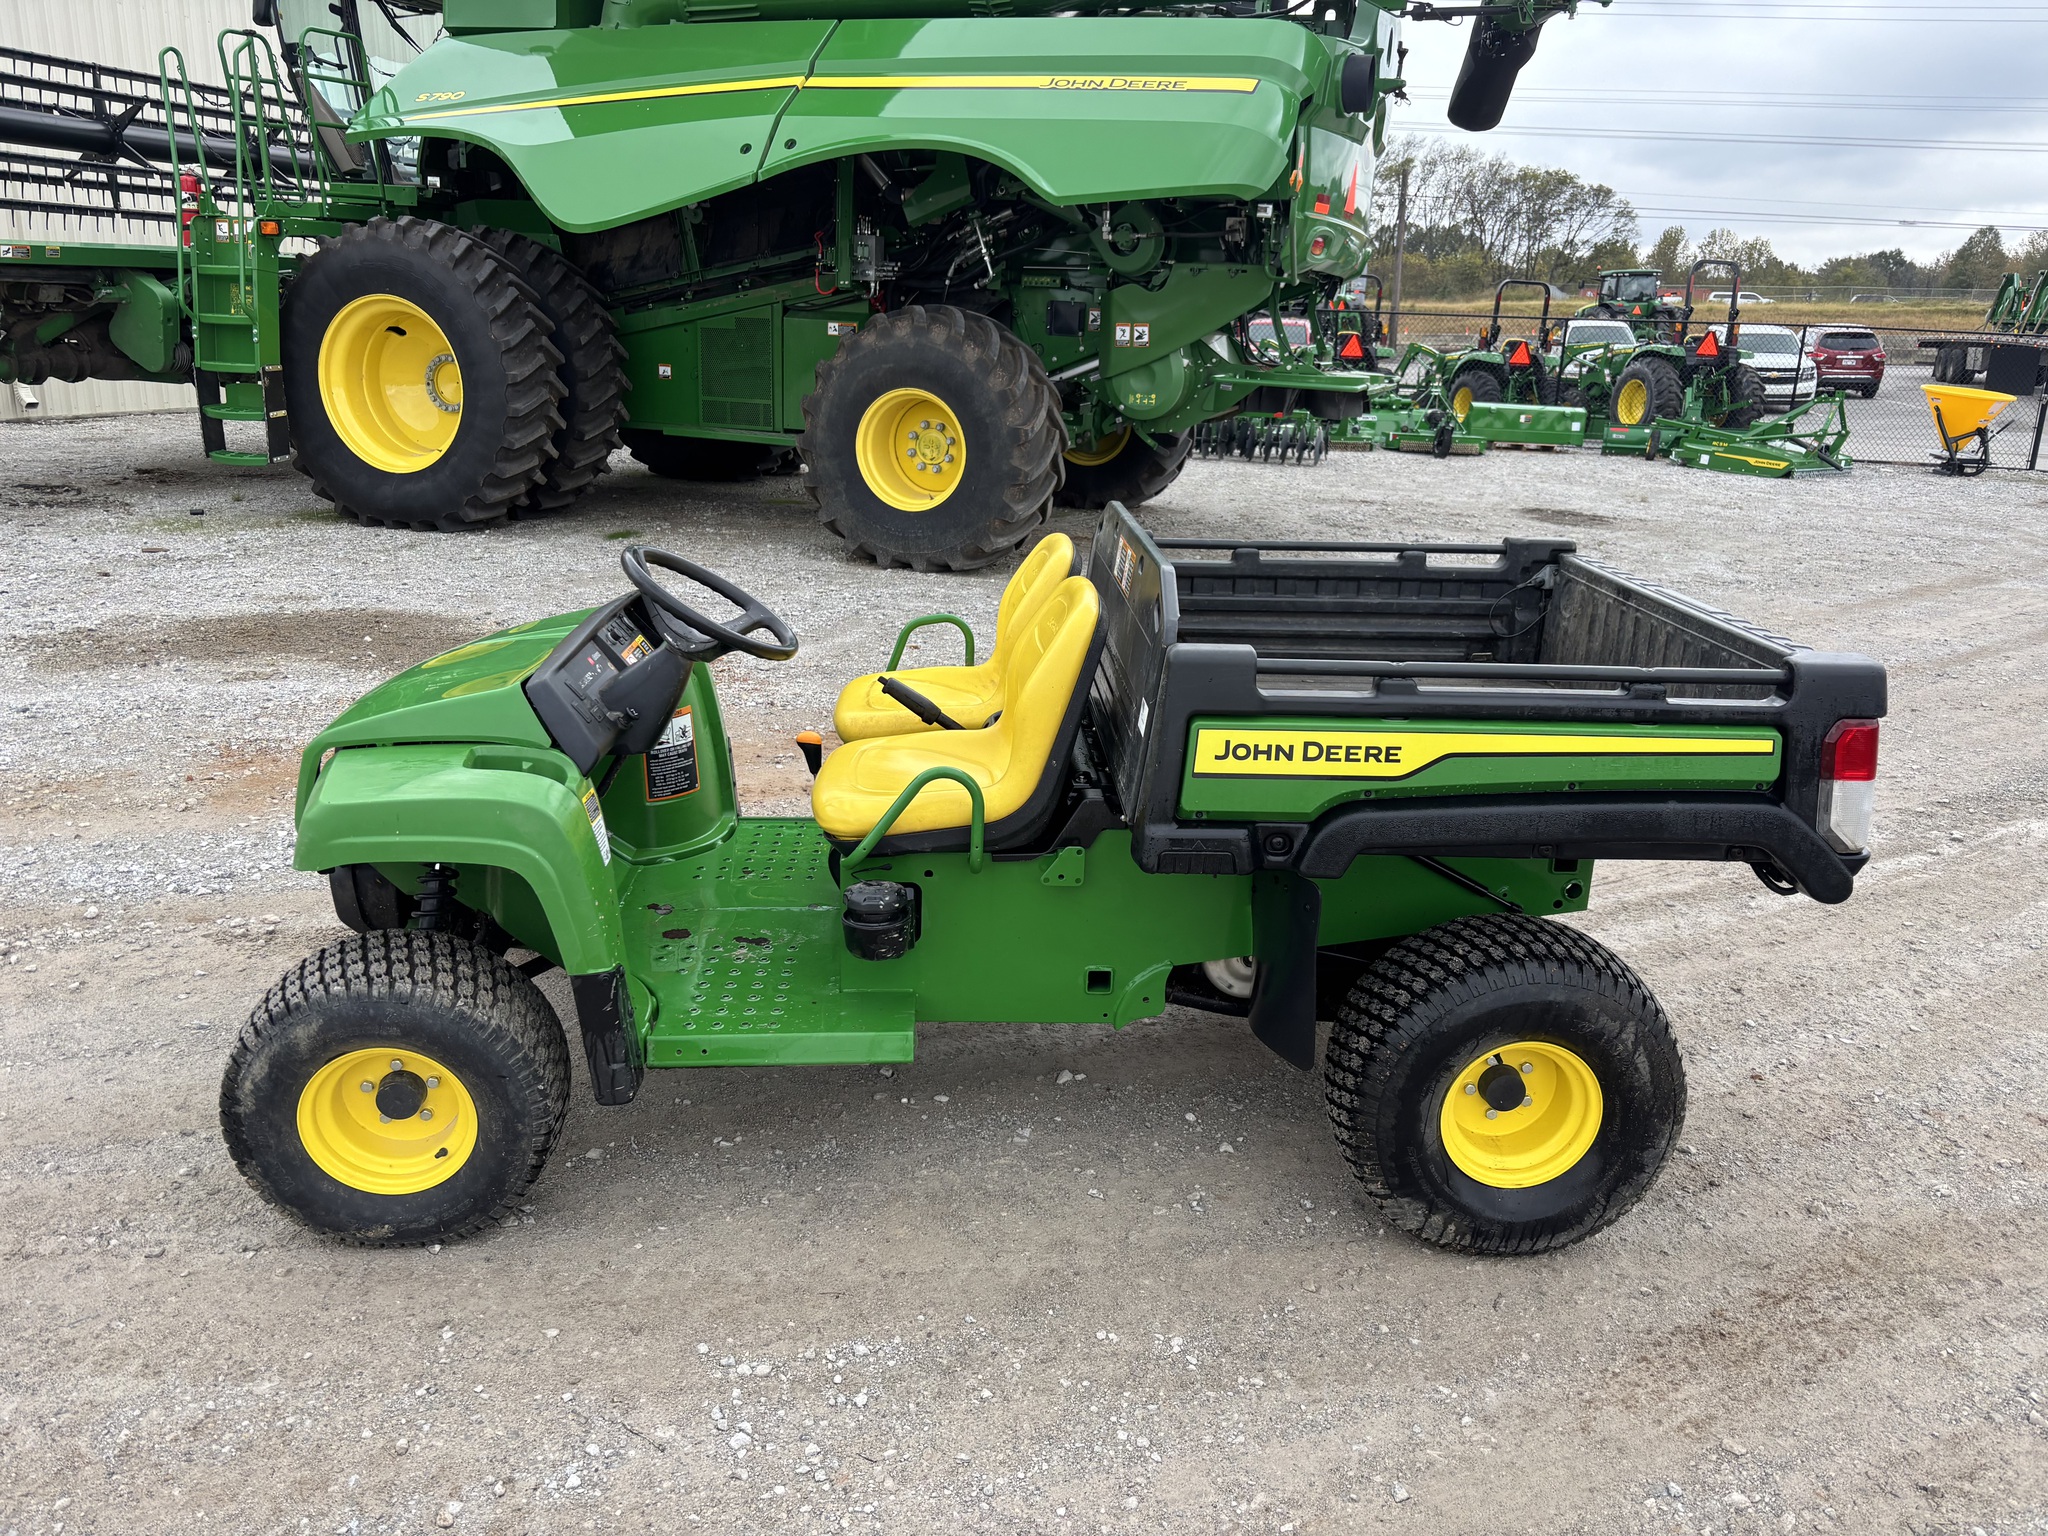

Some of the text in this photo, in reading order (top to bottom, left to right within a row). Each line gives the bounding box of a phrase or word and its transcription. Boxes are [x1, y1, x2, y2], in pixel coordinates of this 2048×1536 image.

[1040, 78, 1188, 89] JOHN DEERE
[414, 91, 466, 102] S790
[1214, 739, 1402, 763] JOHN DEERE
